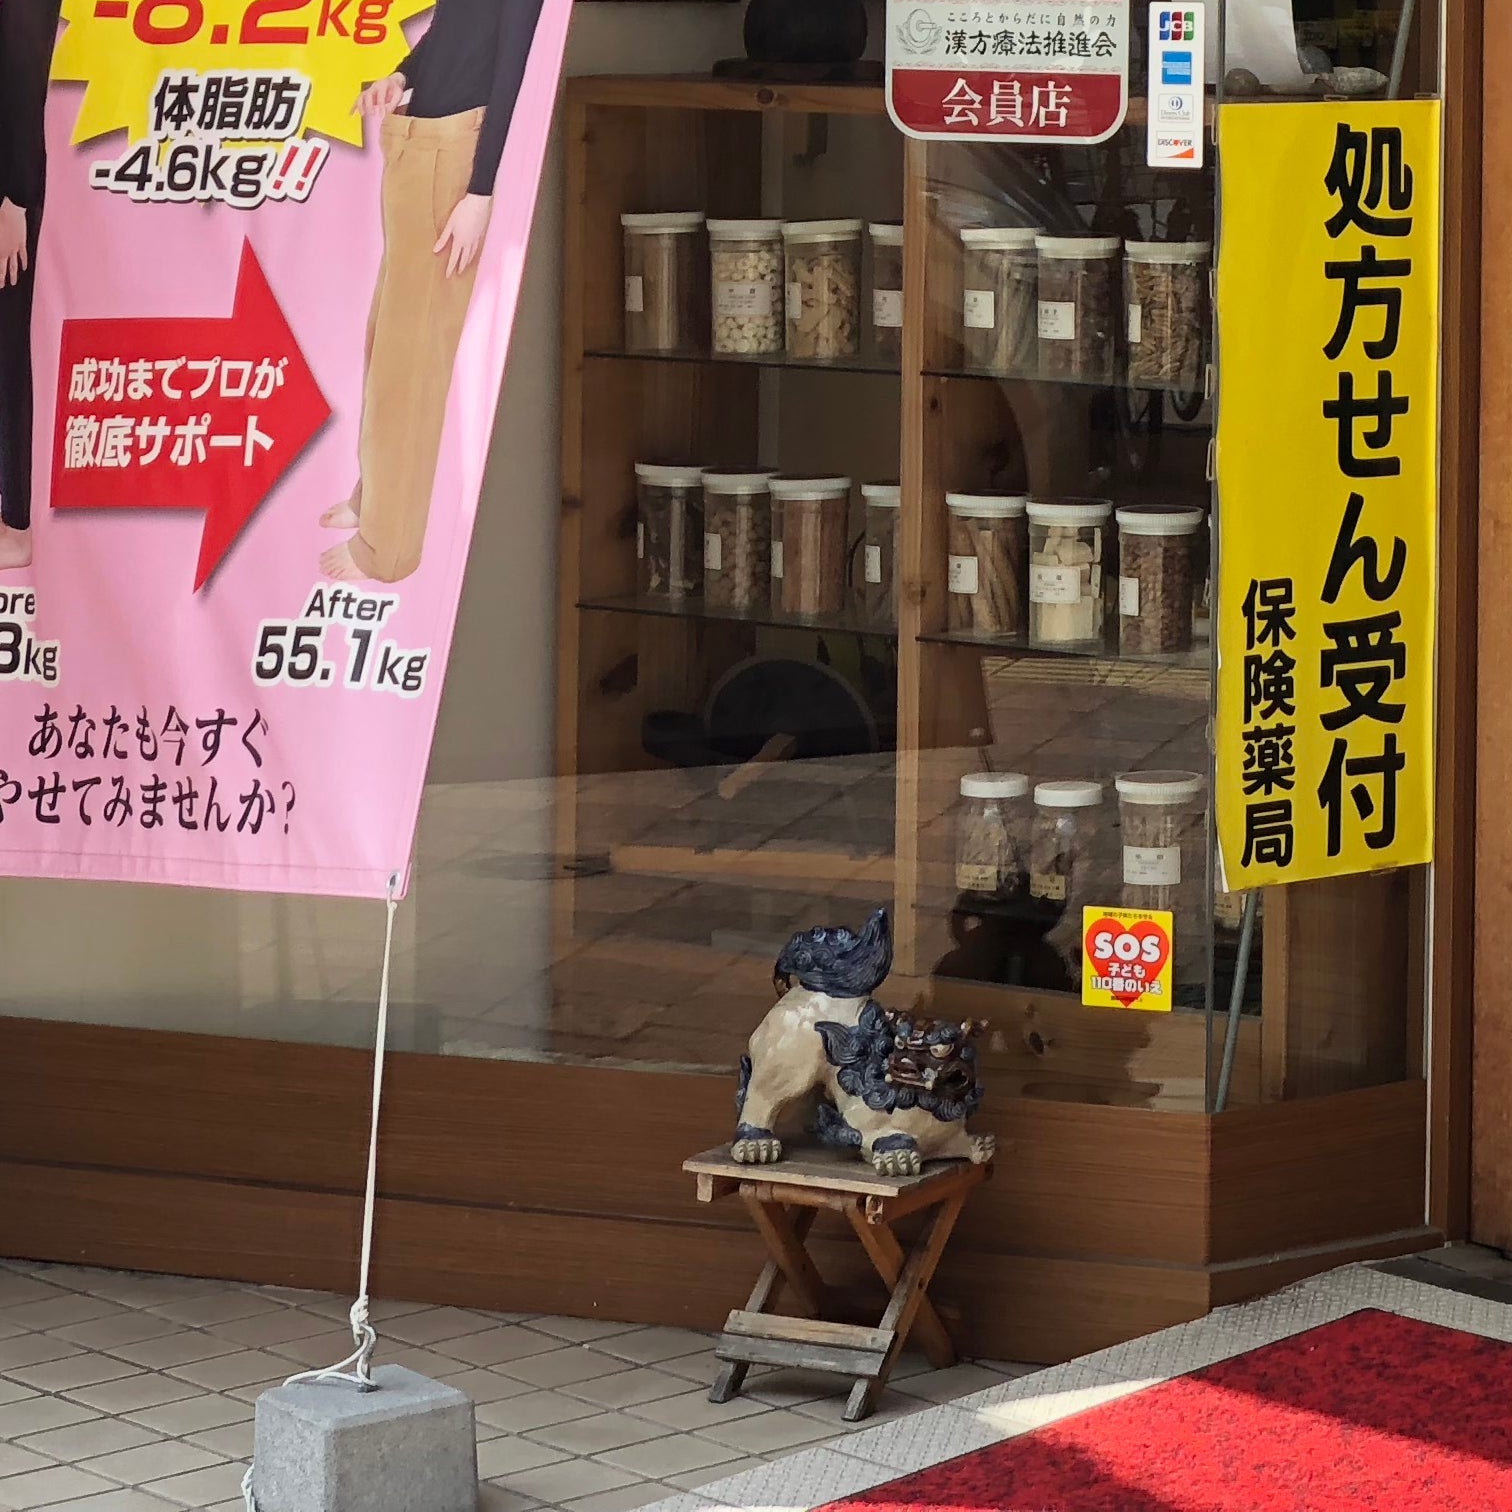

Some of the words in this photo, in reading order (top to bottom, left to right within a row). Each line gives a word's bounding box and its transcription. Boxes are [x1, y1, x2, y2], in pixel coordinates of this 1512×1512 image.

[947, 11, 1117, 28] こころとからだに自然の力
[1159, 11, 1195, 41] JCB
[945, 30, 1117, 58] 漢方療法推進会
[153, 75, 303, 133] 体脂肪
[941, 77, 1073, 129] 会員店
[68, 356, 288, 400] 成功までプロが
[63, 415, 275, 469] 徹底サポート
[1317, 122, 1413, 858] 処方せん受付
[304, 589, 394, 624] After
[27, 702, 270, 768] あなたも今すぐ
[1240, 577, 1296, 868] 保険薬局
[1094, 931, 1161, 963] SOS
[1108, 962, 1146, 979] 子ども
